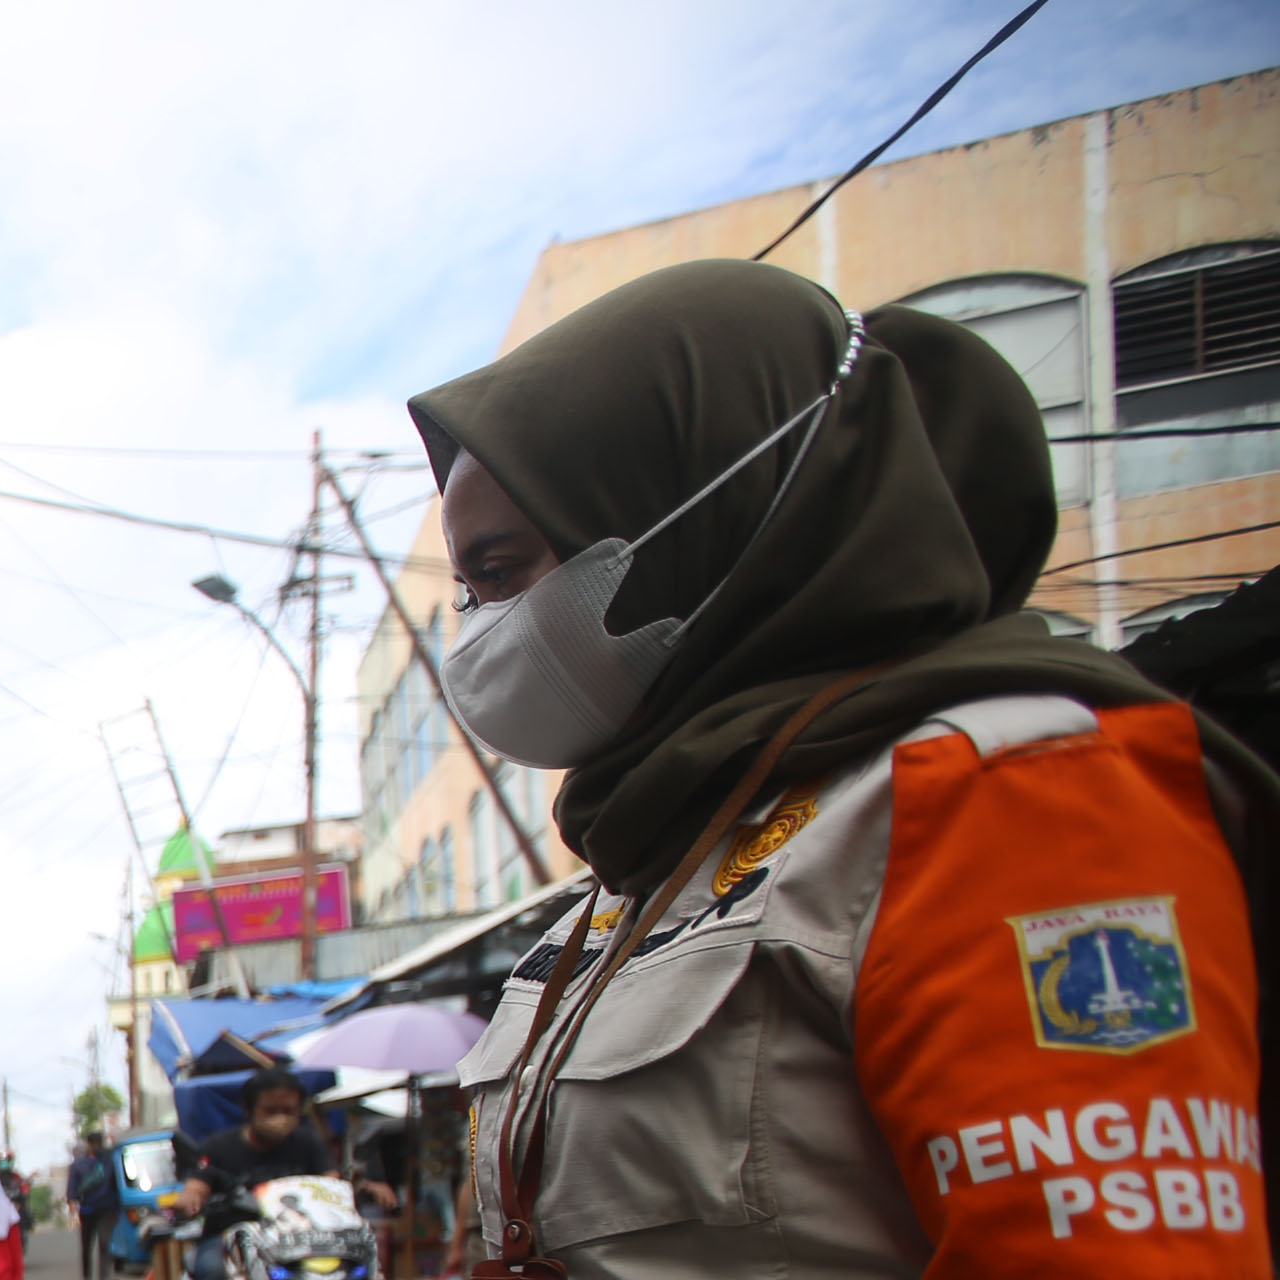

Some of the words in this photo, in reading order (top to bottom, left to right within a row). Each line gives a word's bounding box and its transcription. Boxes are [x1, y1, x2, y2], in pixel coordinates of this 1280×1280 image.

[1025, 913, 1086, 933] JAYA
[1103, 903, 1163, 920] RAYA
[1042, 1169, 1245, 1239] PSBB
